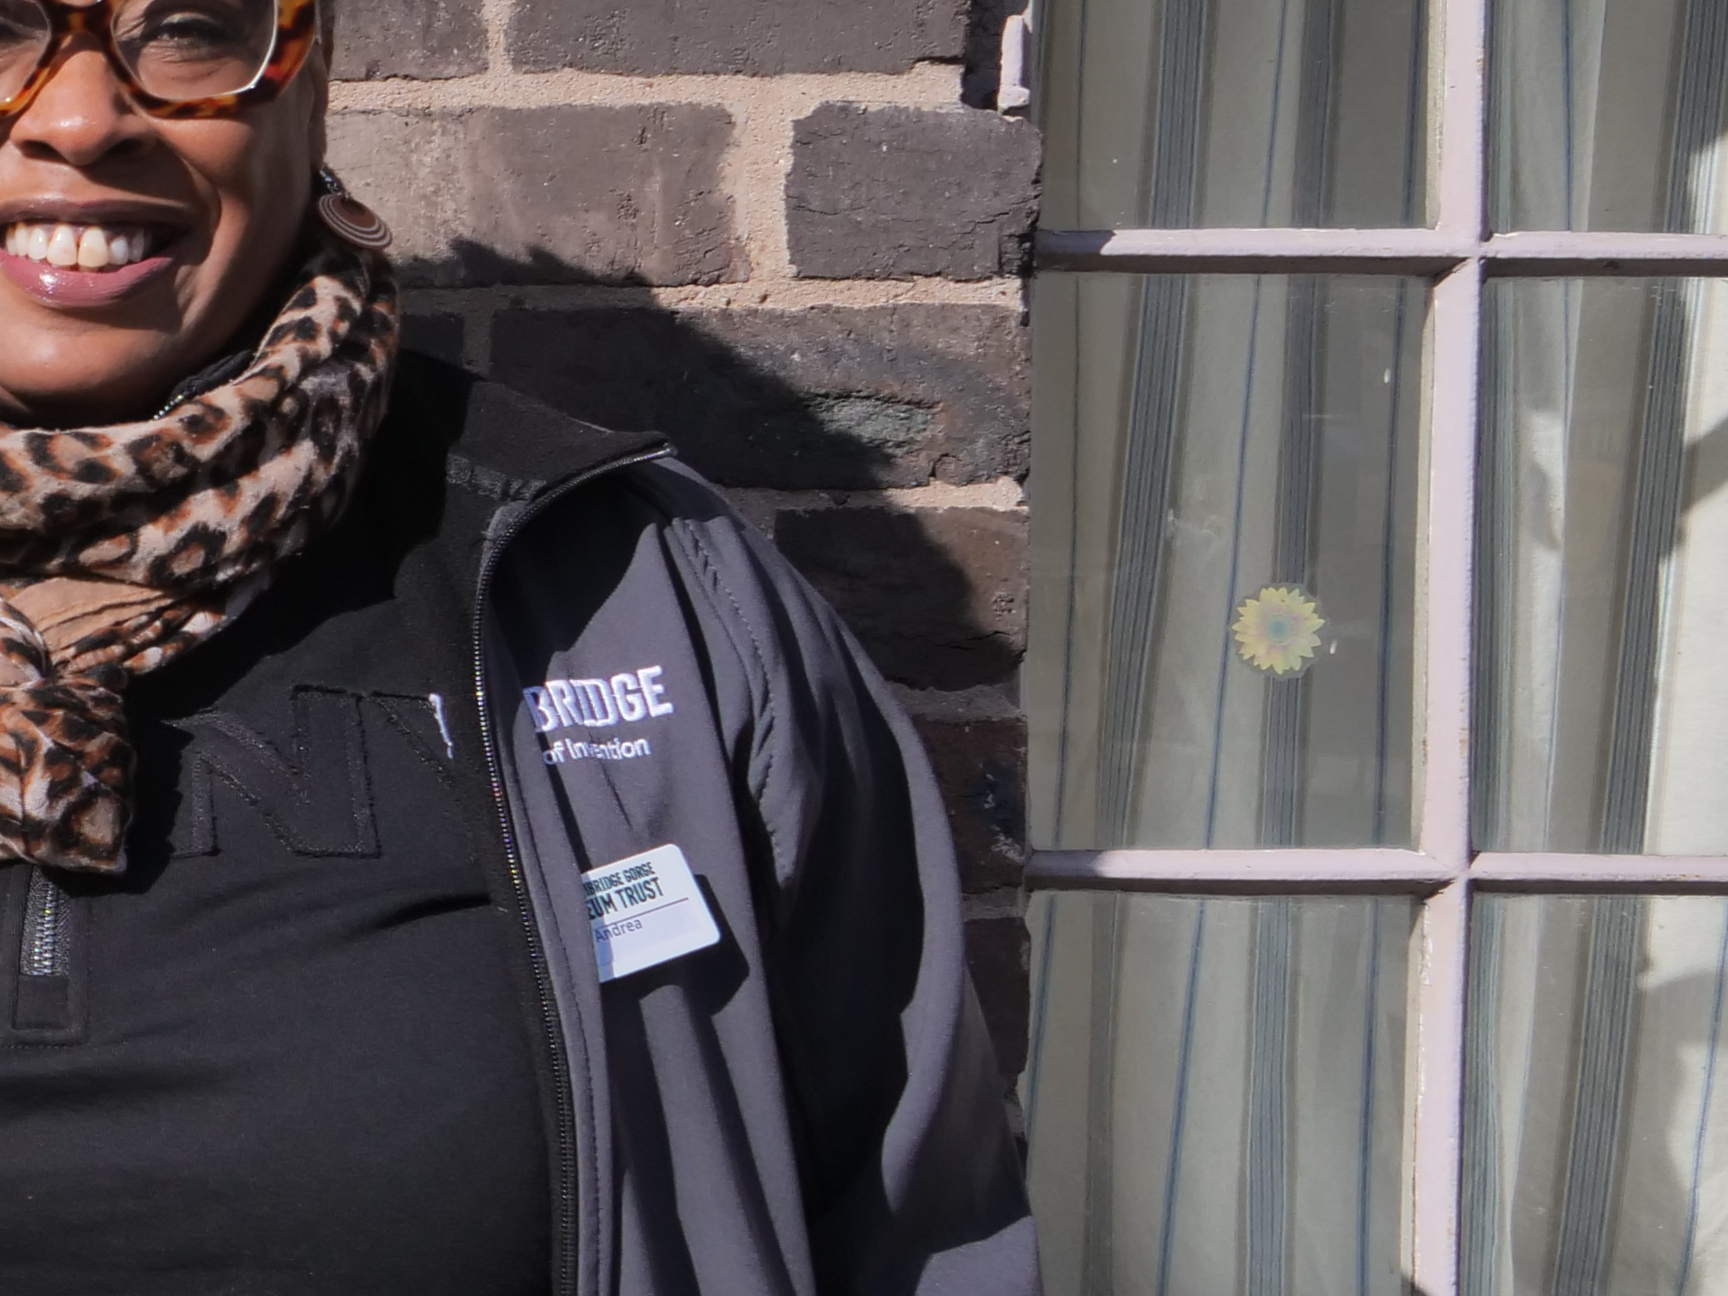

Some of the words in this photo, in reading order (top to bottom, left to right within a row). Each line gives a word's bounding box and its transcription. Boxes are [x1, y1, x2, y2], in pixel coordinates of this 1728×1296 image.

[543, 740, 566, 766] of
[622, 861, 656, 883] GORGE
[614, 877, 664, 909] TRUST
[594, 919, 643, 943] Andrea
